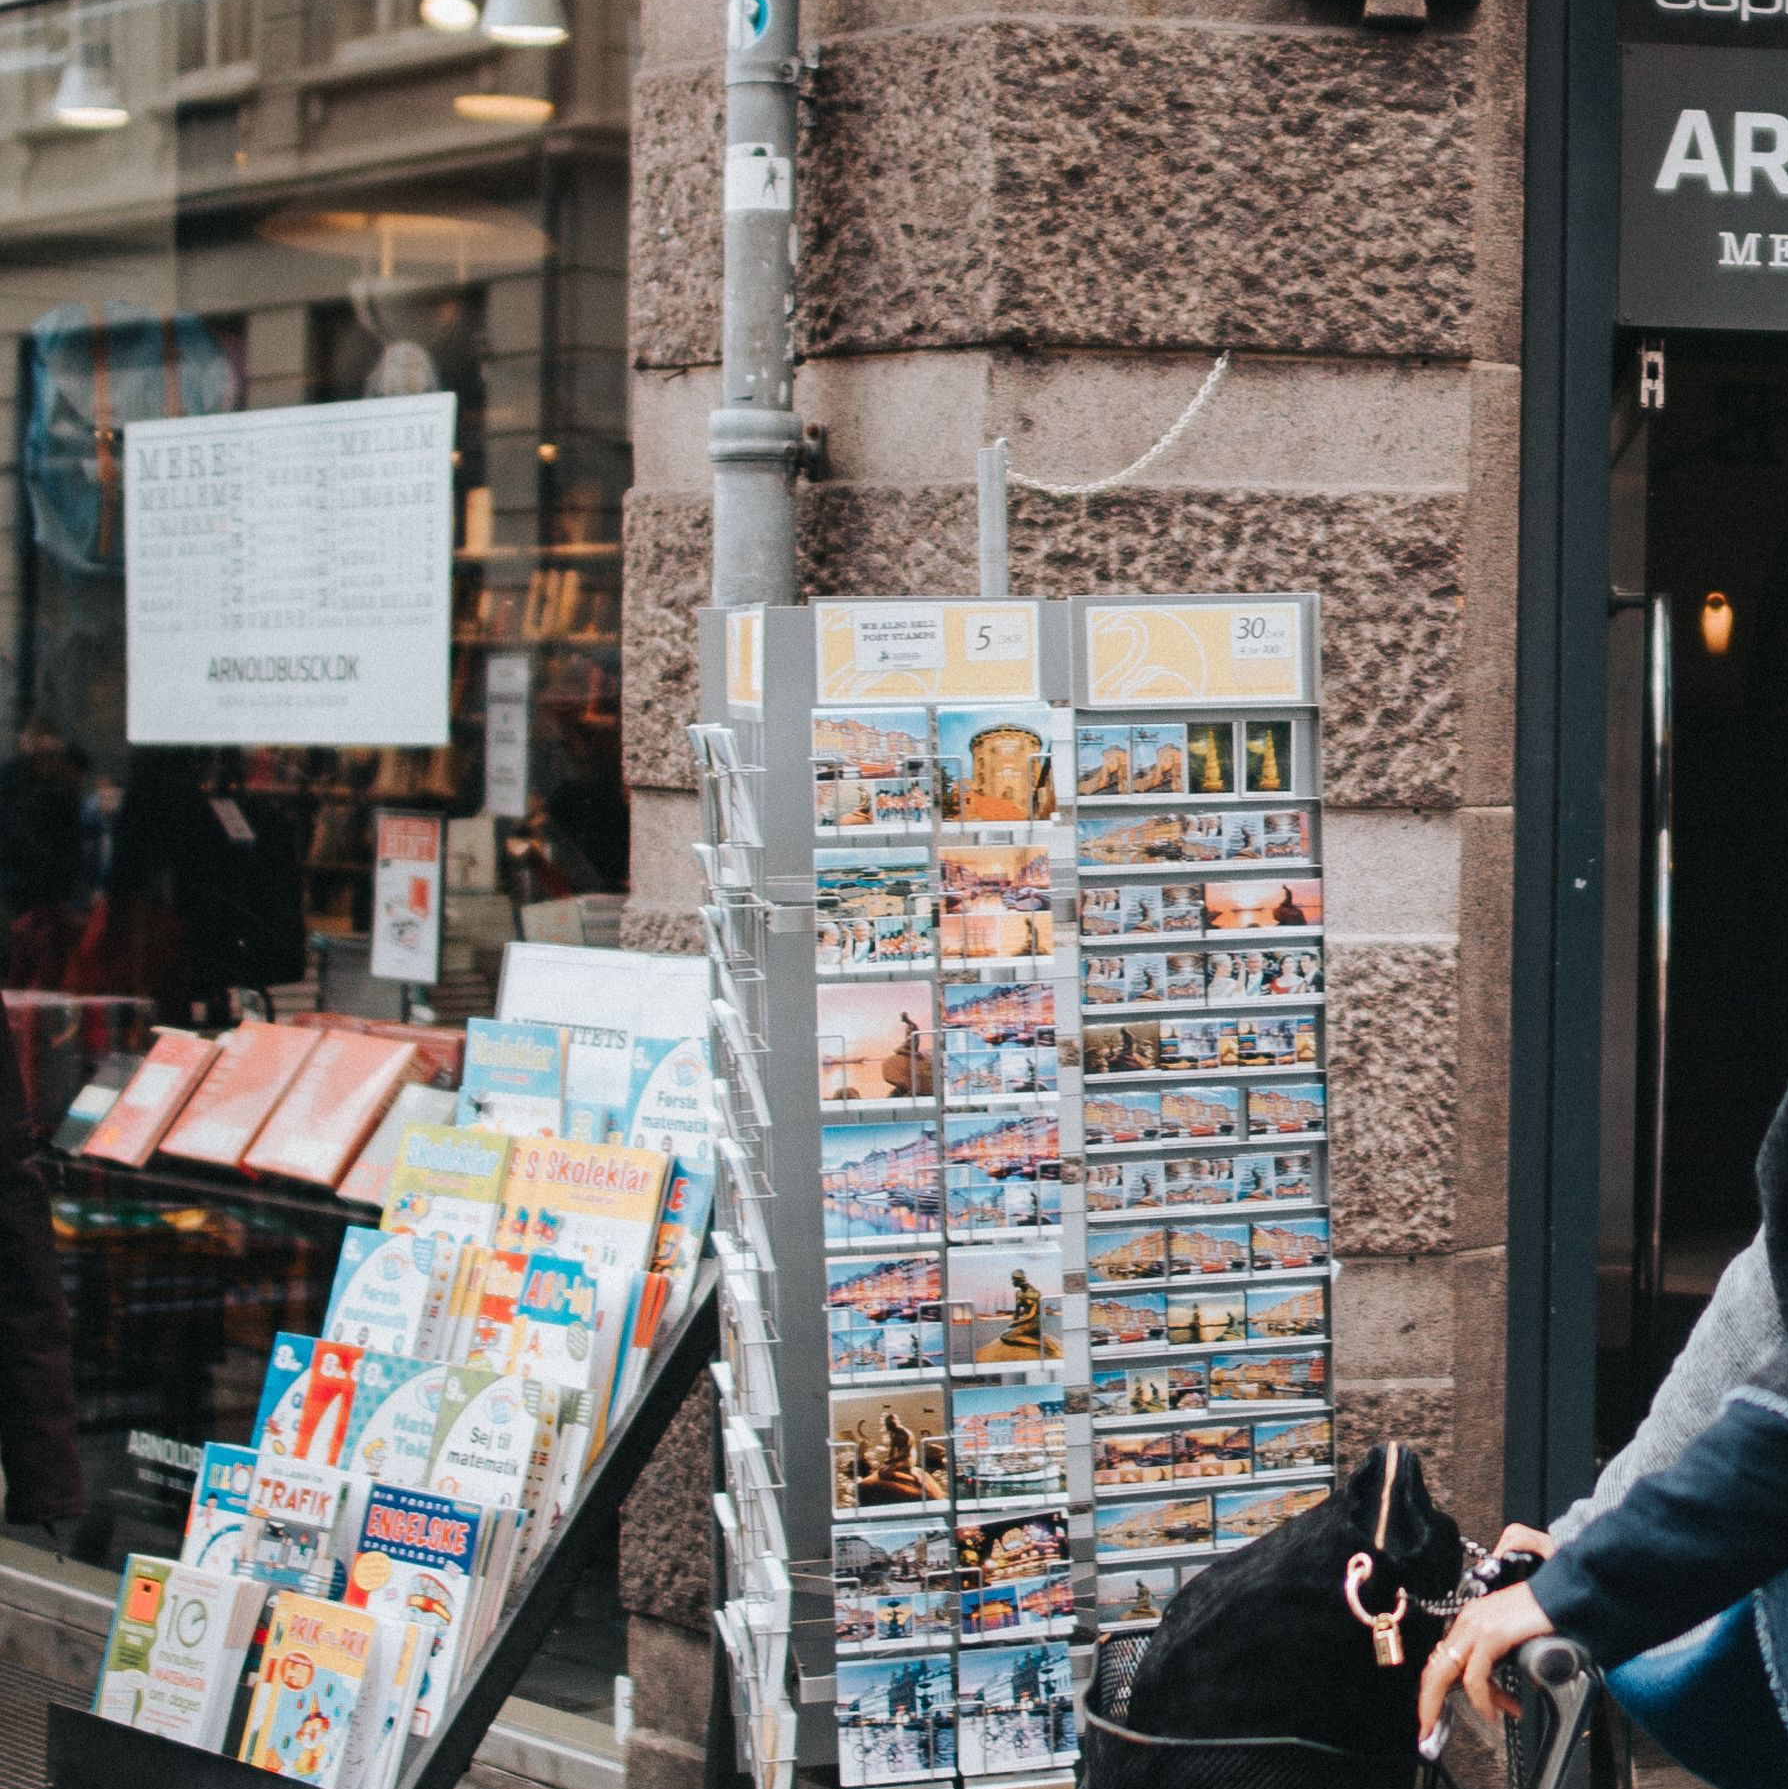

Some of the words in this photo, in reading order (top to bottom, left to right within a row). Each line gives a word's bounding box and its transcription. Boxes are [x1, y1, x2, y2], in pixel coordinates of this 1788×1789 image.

[975, 625, 993, 651] 5
[1236, 617, 1266, 640] 30
[207, 653, 361, 684] ARNOLDBUSCK.DK
[547, 1149, 652, 1194] Skoleklar
[470, 1425, 493, 1451] Sej
[498, 1432, 512, 1450] til
[447, 1449, 520, 1477] matematik
[259, 1477, 332, 1516] TRAFIK
[365, 1503, 472, 1556] ENGELSKE
